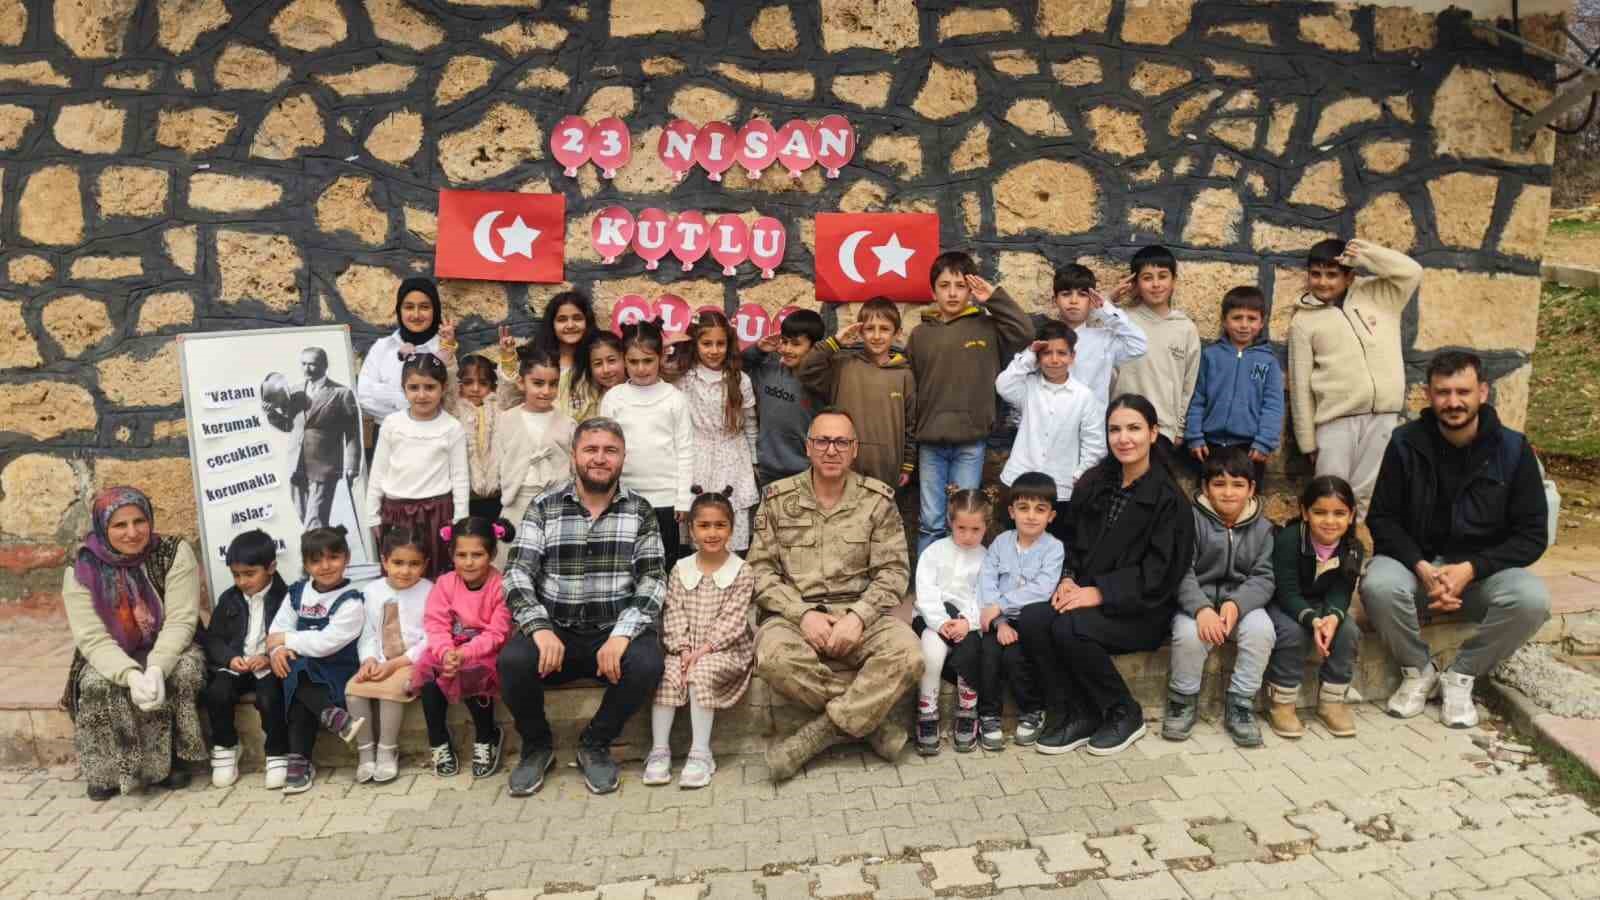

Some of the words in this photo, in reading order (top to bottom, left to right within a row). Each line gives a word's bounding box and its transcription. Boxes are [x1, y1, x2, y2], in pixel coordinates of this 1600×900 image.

[561, 127, 622, 157] 23
[663, 127, 849, 161] NISAN
[597, 217, 781, 257] KUTLU
[617, 303, 785, 342] OLU
[765, 385, 796, 402] adidas
[201, 415, 261, 435] korumak
[206, 472, 277, 501] korumakla
